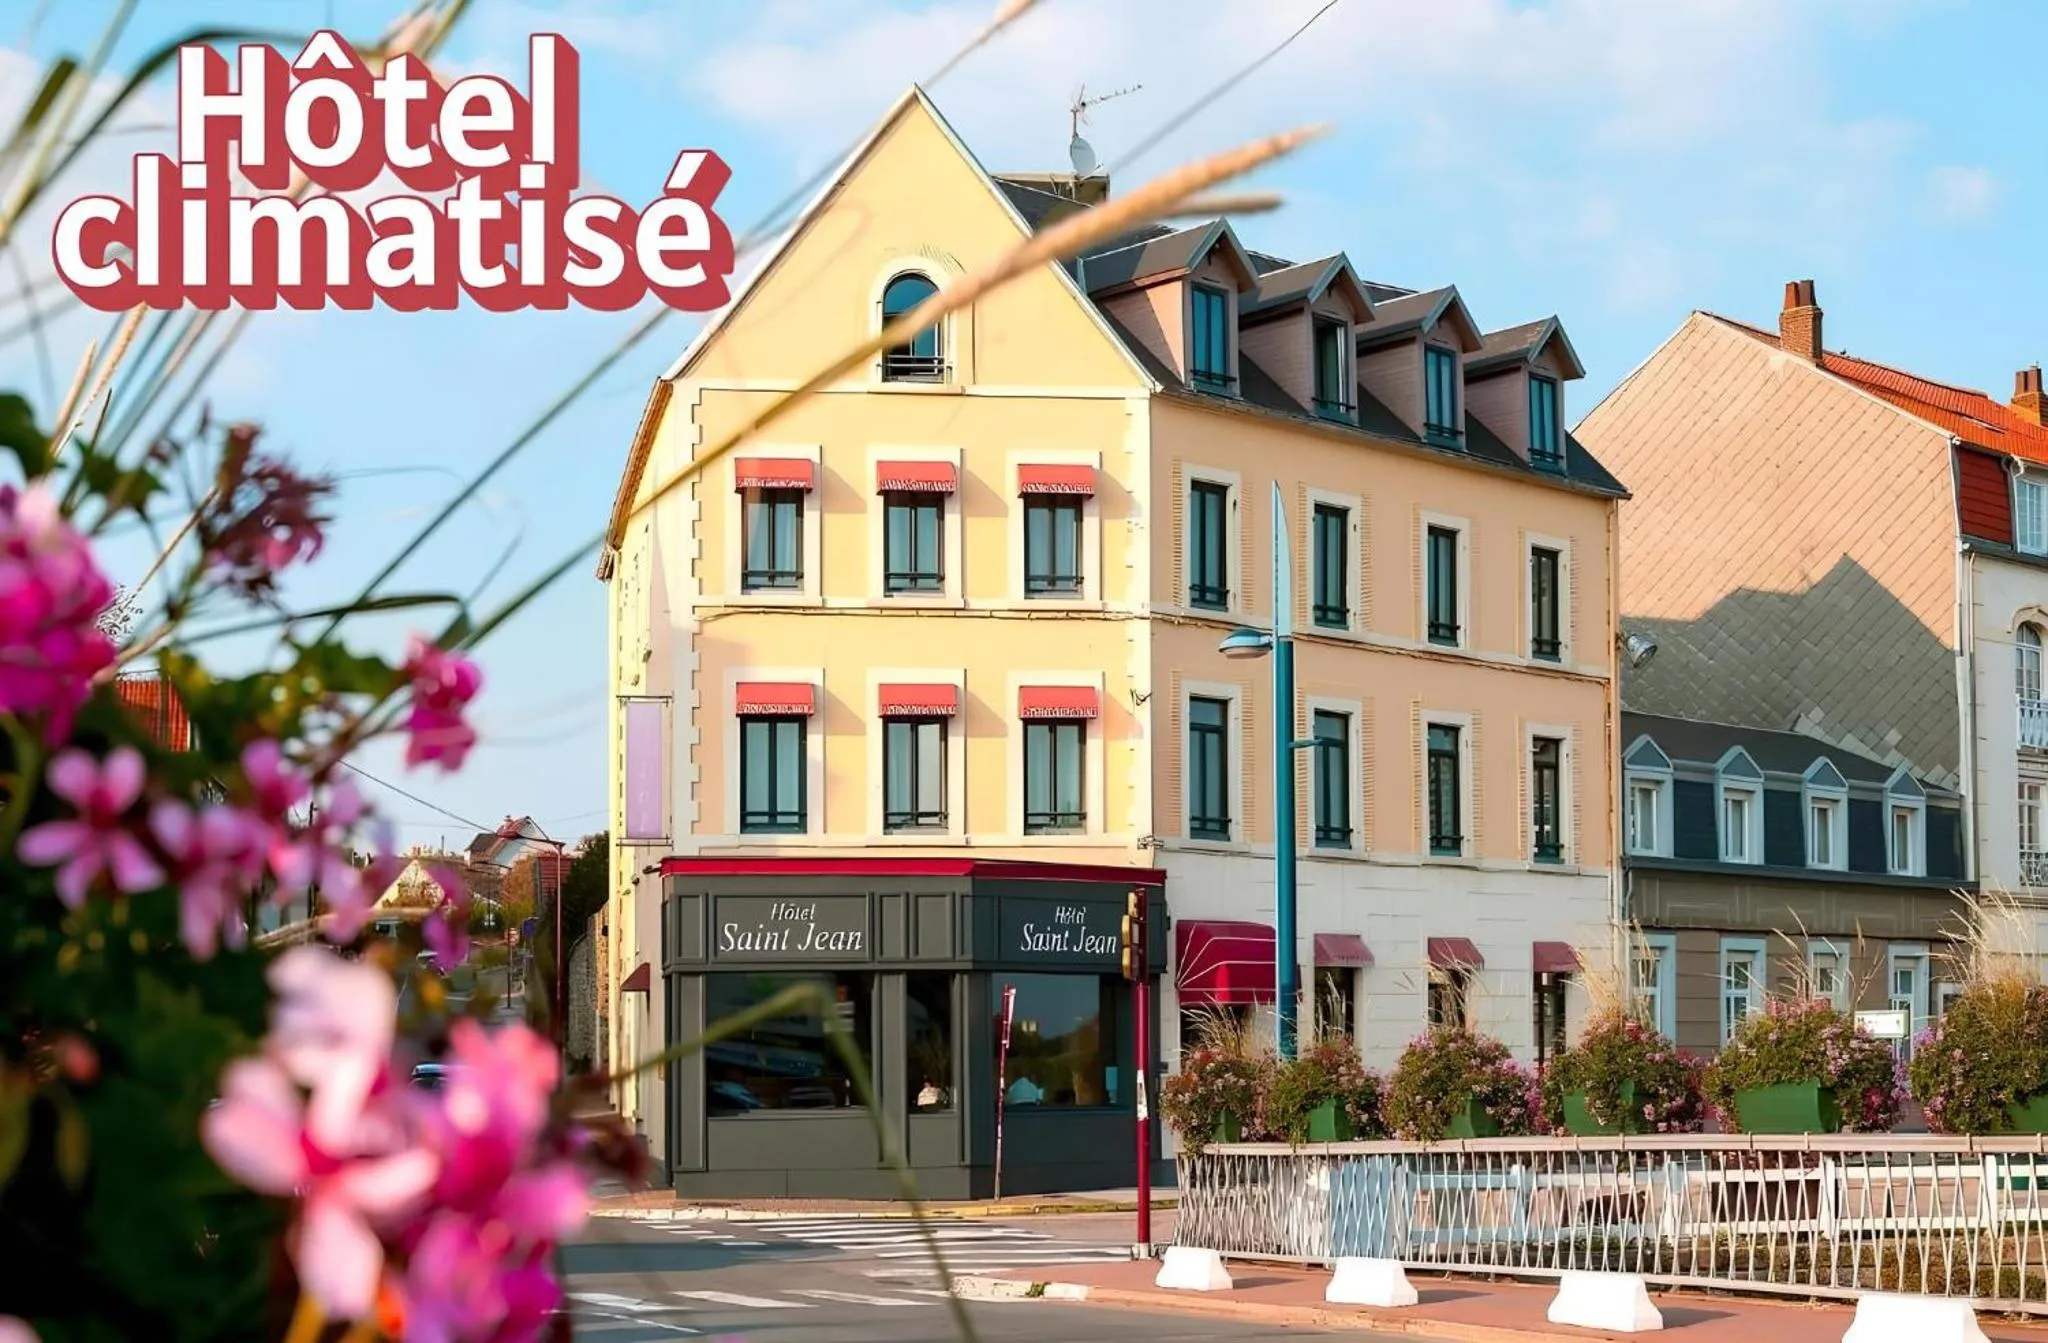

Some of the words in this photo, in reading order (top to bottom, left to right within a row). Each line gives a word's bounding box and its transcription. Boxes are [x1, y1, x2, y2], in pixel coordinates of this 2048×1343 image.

[770, 902, 817, 921] Hôtel
[719, 923, 790, 952] Saint
[797, 922, 863, 952] Jean
[1020, 923, 1070, 952] Saint
[1072, 926, 1118, 954] Jean
